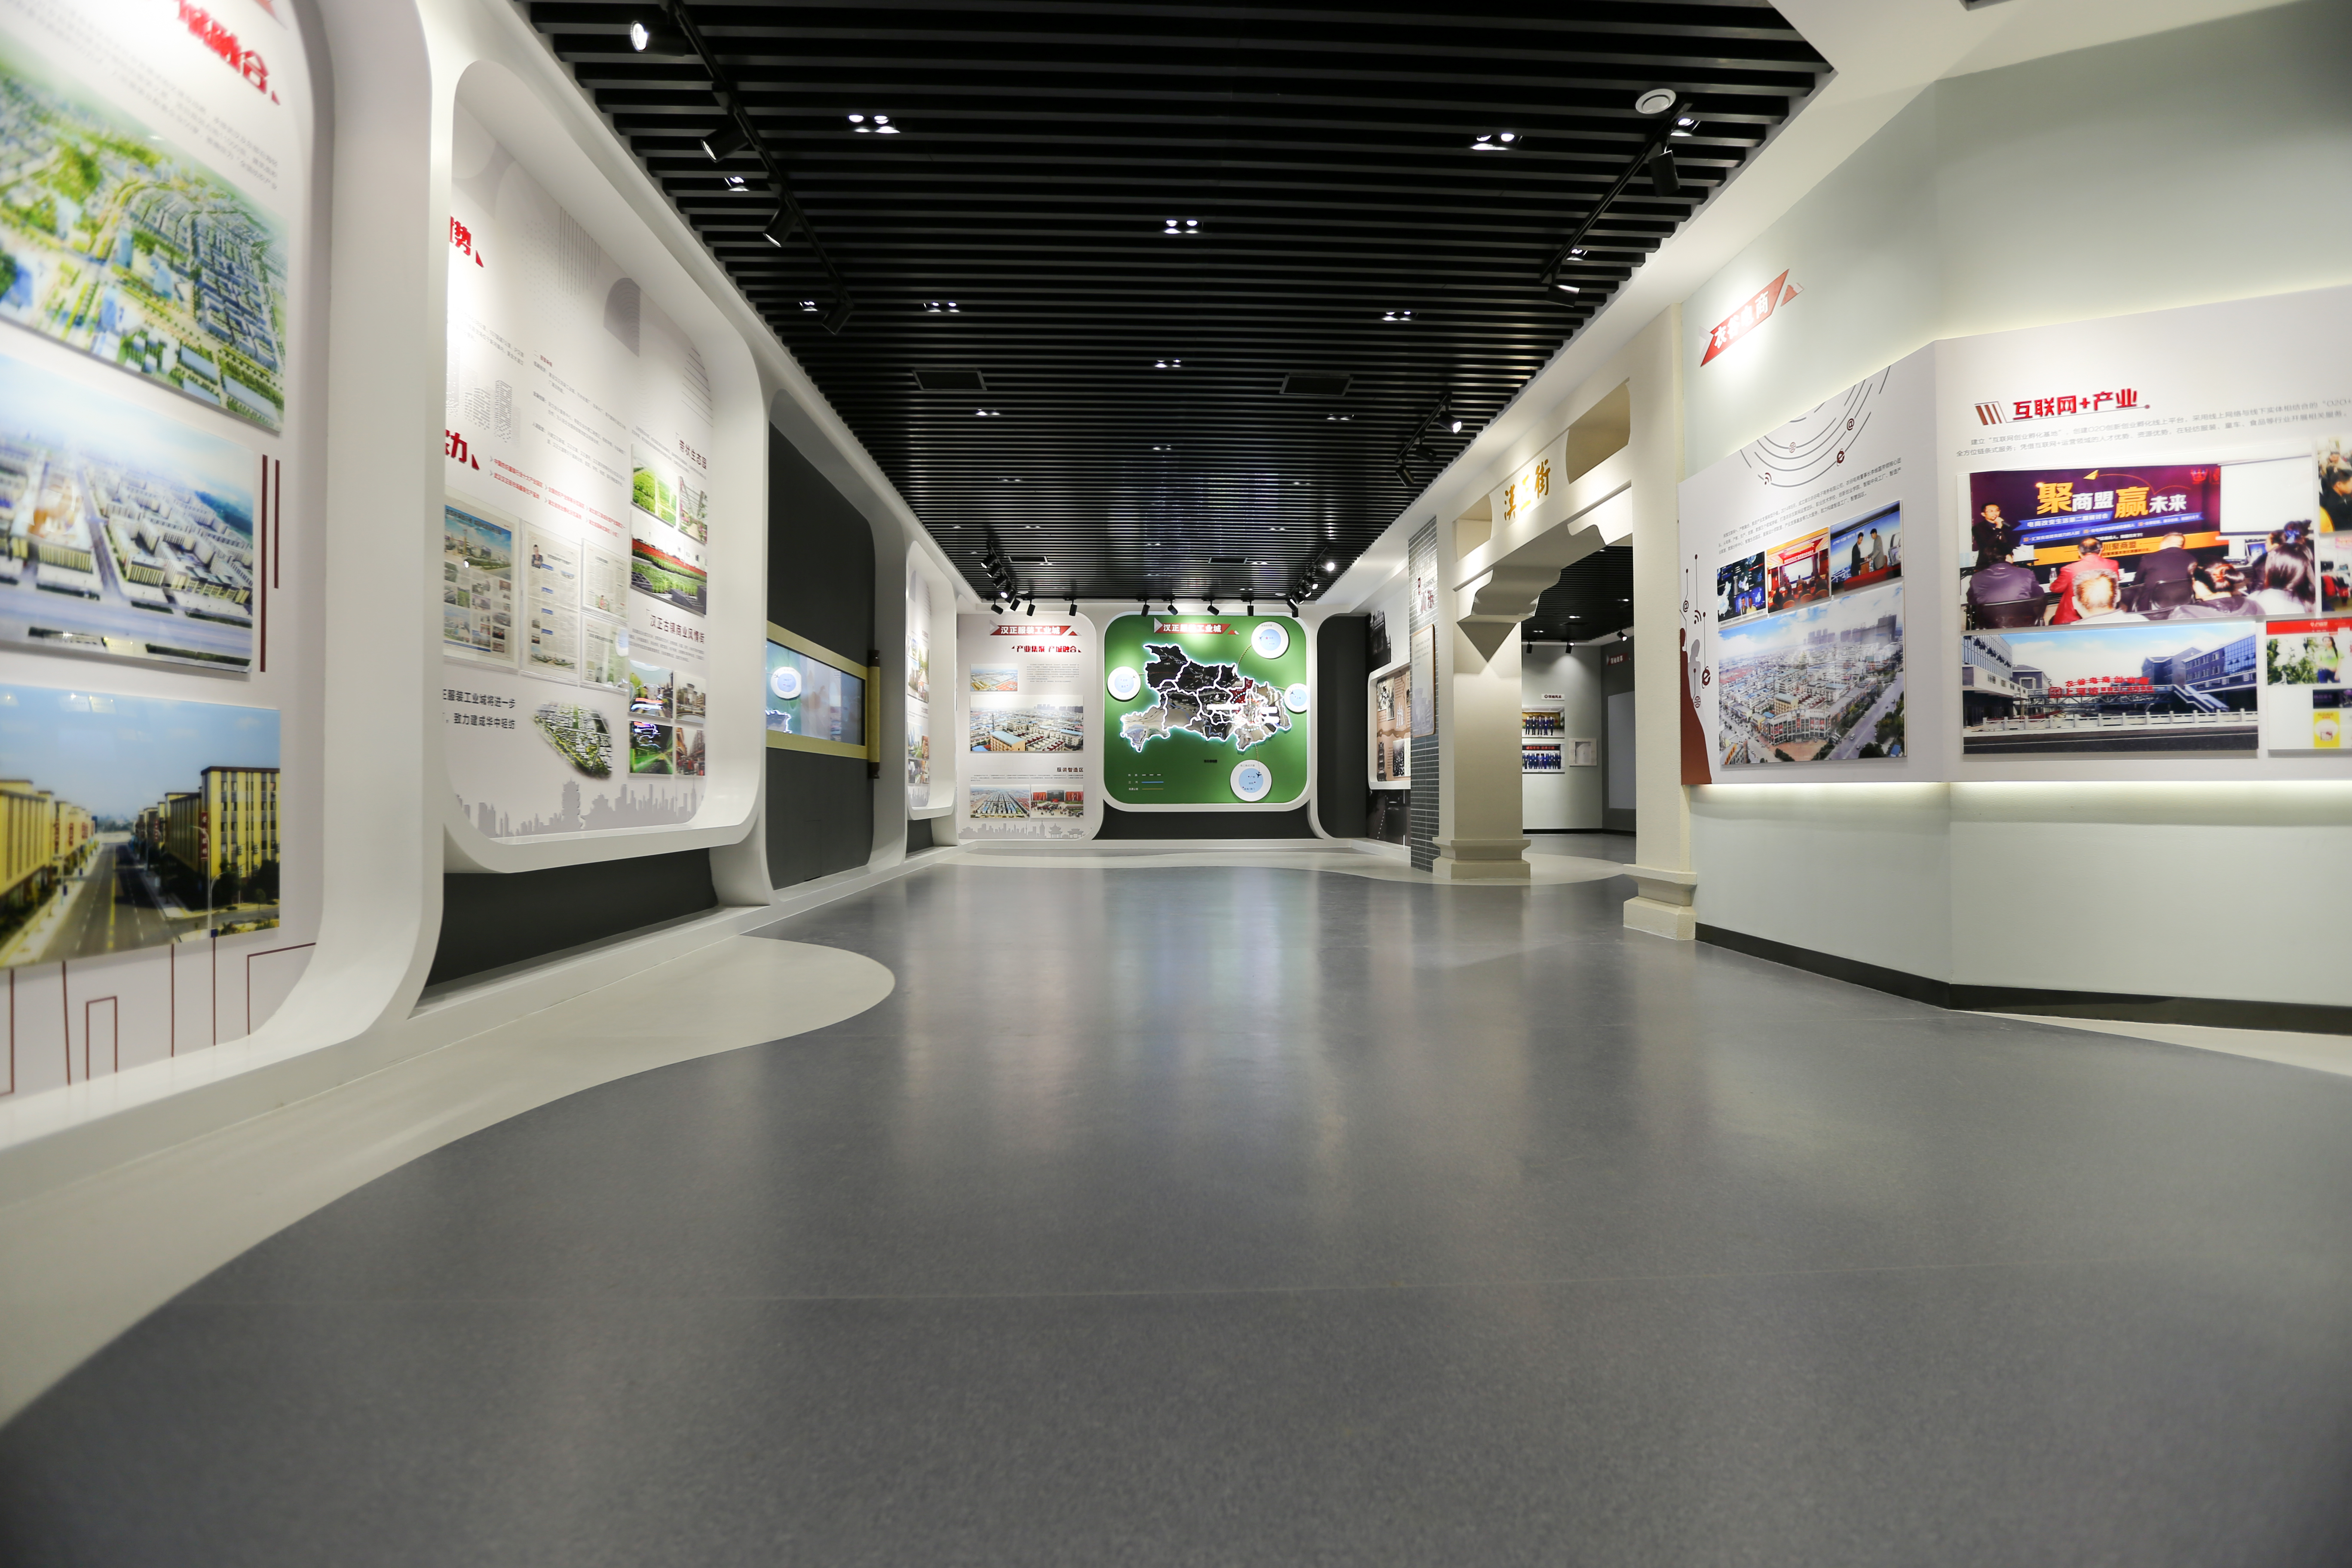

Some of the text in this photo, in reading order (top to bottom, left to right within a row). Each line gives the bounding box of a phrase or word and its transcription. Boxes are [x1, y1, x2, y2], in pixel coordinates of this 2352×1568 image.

[1714, 291, 1769, 349] 衣谷电商
[2012, 388, 2138, 420] 互联网+产业
[679, 439, 707, 469] 带状生态园
[2027, 513, 2108, 527] 电商改变生活第二期研讨会
[650, 614, 704, 644] 汉正古镇商业风情街
[1001, 626, 1061, 634] 汉正服装工业城
[442, 712, 515, 729] ，致力建成华中轻纺
